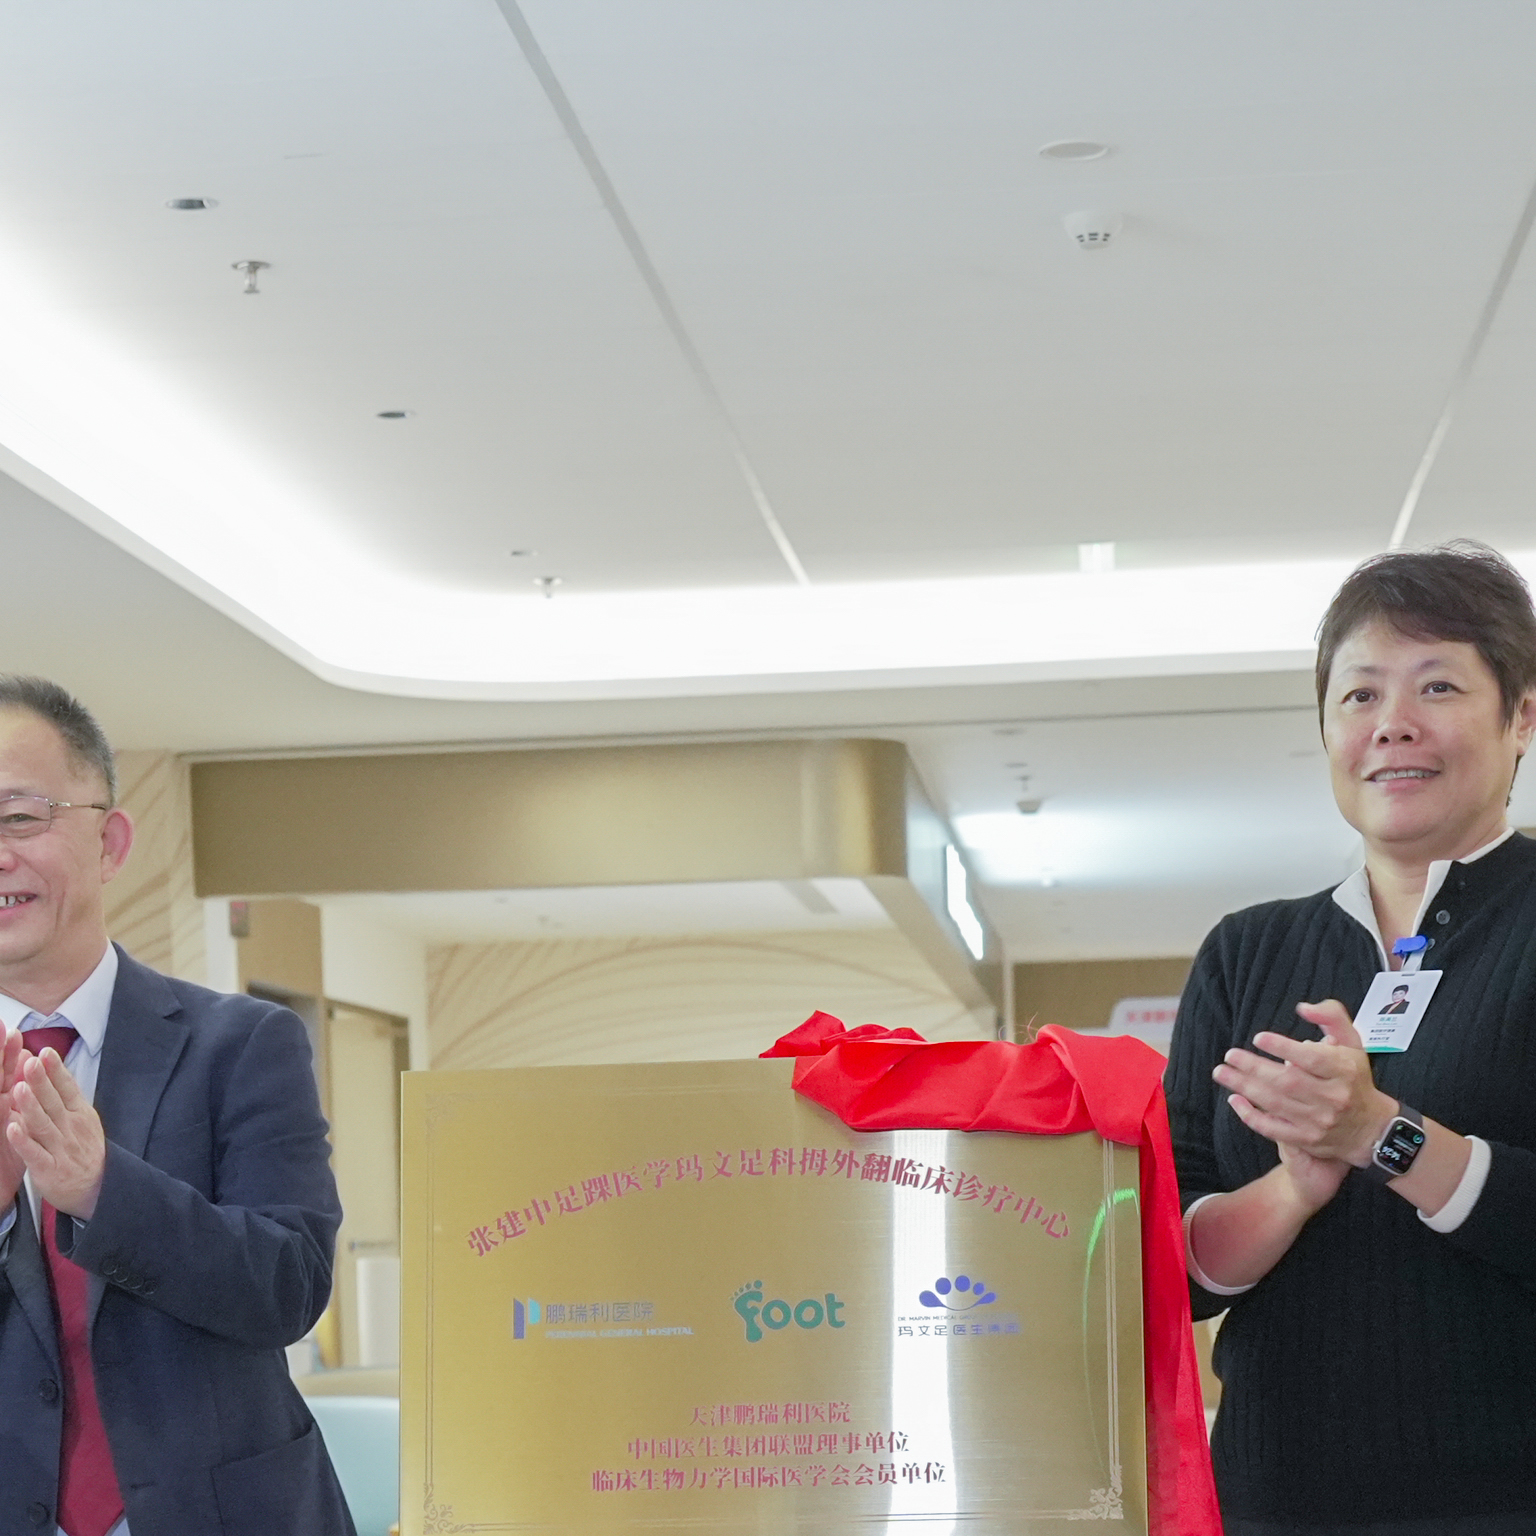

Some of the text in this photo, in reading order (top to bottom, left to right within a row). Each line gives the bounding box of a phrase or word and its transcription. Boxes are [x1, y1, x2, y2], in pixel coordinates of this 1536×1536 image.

[465, 1147, 1070, 1257] 张建中足踝医学玛文足科拇外翻临床诊疗中心
[546, 1301, 654, 1324] 鹏瑞利医院
[647, 1326, 695, 1336] HOSPITAL
[690, 1401, 851, 1427] 天津鹏瑞利医院
[627, 1431, 910, 1460] 中国医生集团联盟理事单位
[591, 1462, 946, 1493] 临床生物力学国际医学会会员单位
